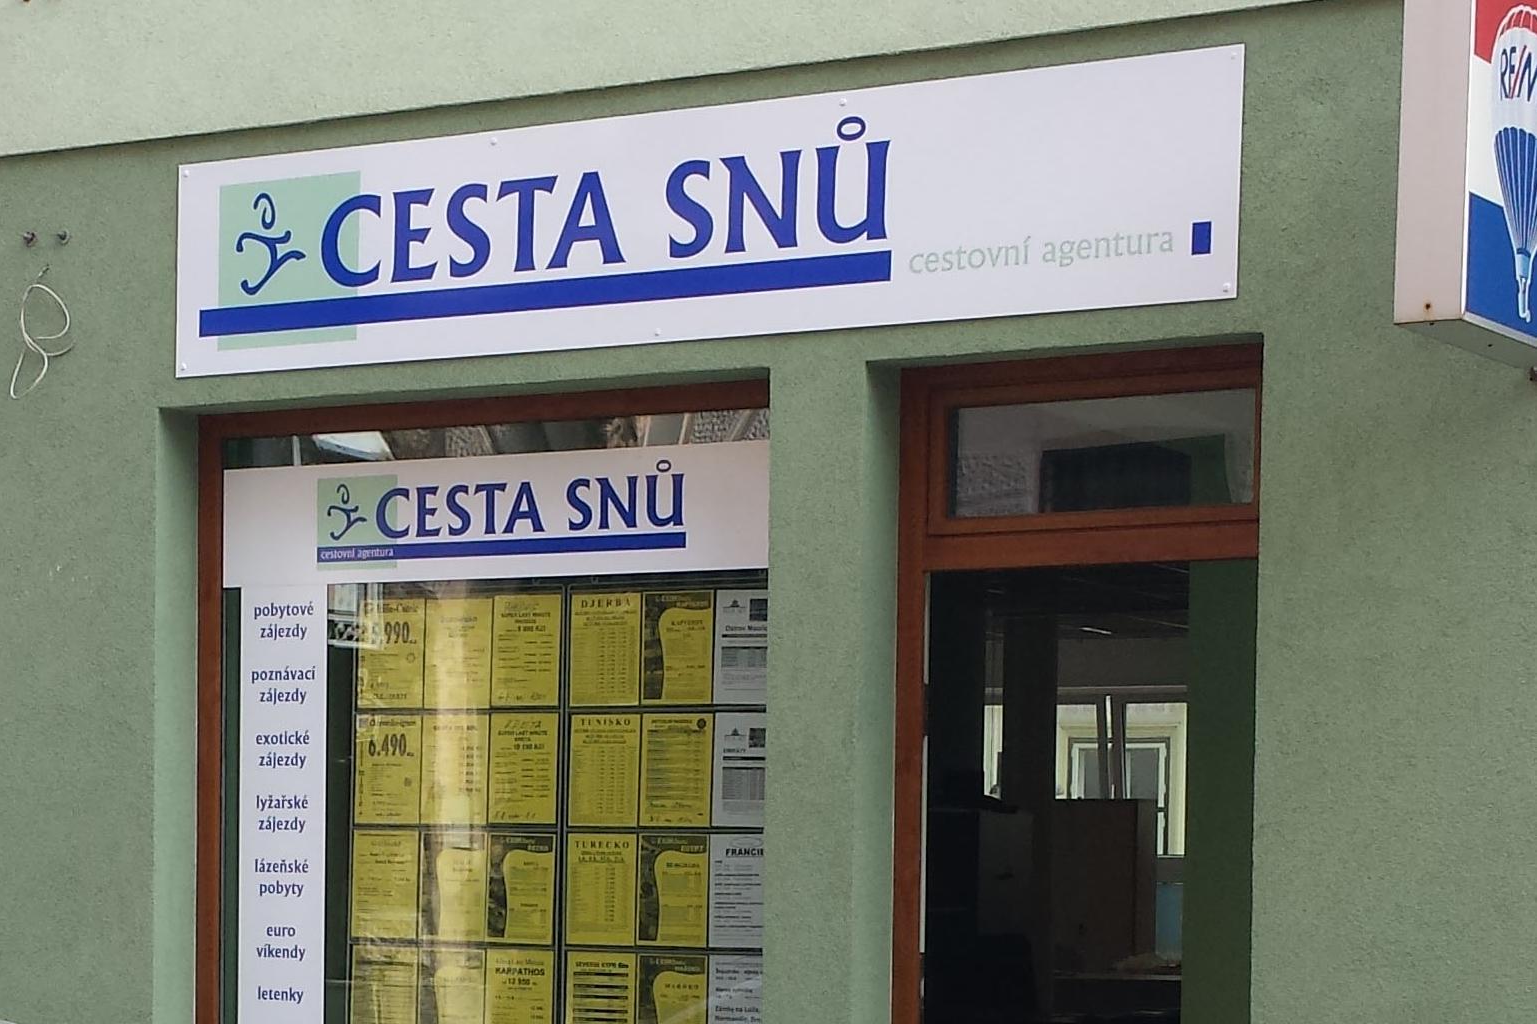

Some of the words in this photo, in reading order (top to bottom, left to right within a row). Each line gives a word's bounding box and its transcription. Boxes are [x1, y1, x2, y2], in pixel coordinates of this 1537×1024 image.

[320, 171, 626, 289] CESTA
[667, 116, 891, 258] SNŮ
[908, 235, 1031, 274] cestovní
[1042, 230, 1175, 267] agentura
[375, 481, 545, 539] CESTA
[567, 459, 685, 531] SNŮ
[254, 601, 314, 620] pobytové
[260, 623, 307, 640] zájezdy
[251, 665, 316, 684] poznávací
[259, 688, 307, 705] zájezdy
[256, 730, 310, 745] exotické
[258, 752, 307, 769] zájezdy
[256, 795, 309, 812] lyžařské
[258, 816, 306, 833] zájezdy
[254, 858, 309, 874] lázeňské
[259, 880, 304, 897] pobyty
[266, 925, 296, 937] euro
[256, 943, 306, 962] víkendy
[257, 985, 304, 1004] letenky
